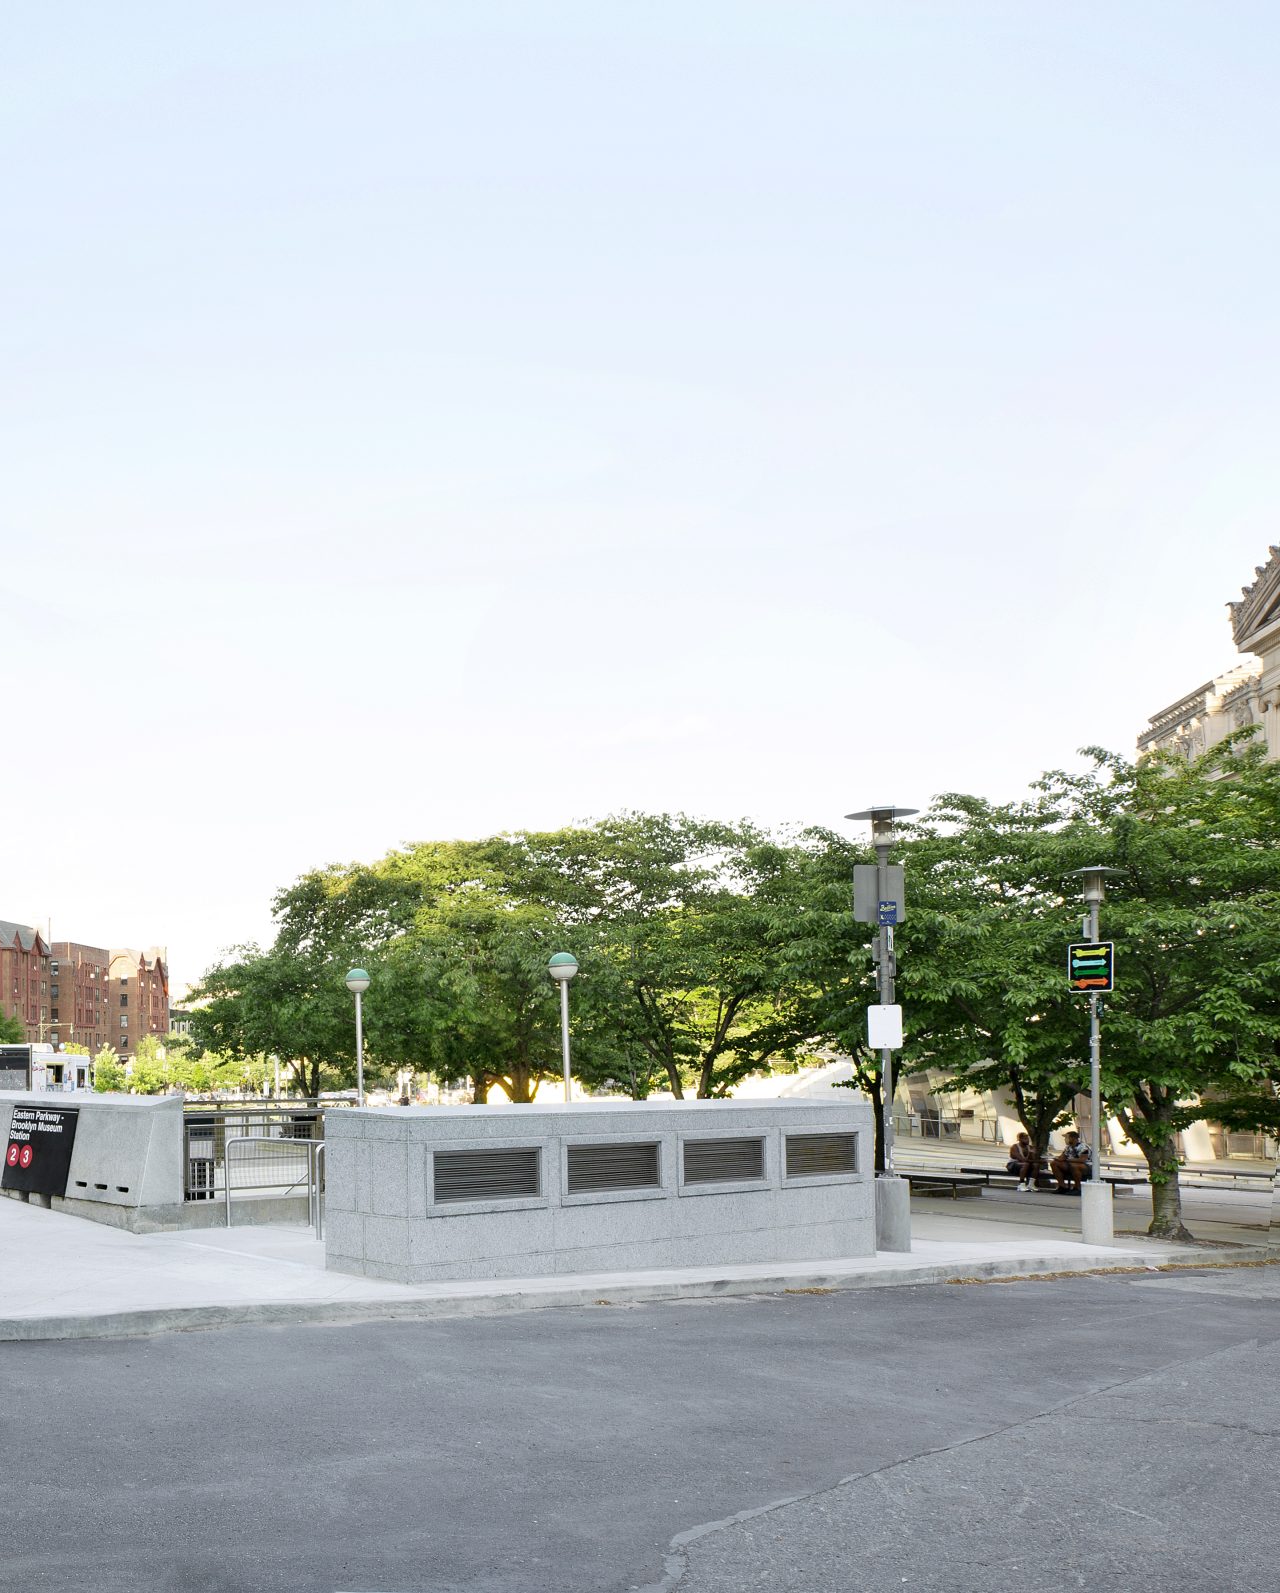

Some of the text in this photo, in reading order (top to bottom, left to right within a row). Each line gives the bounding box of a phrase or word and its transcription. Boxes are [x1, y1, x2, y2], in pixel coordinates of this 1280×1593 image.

[13, 1110, 35, 1120] Eastern
[35, 1111, 61, 1124] Parkway
[11, 1120, 63, 1133] Brooklyn Museum
[10, 1130, 30, 1140] Station
[10, 1148, 30, 1163] 2 3
